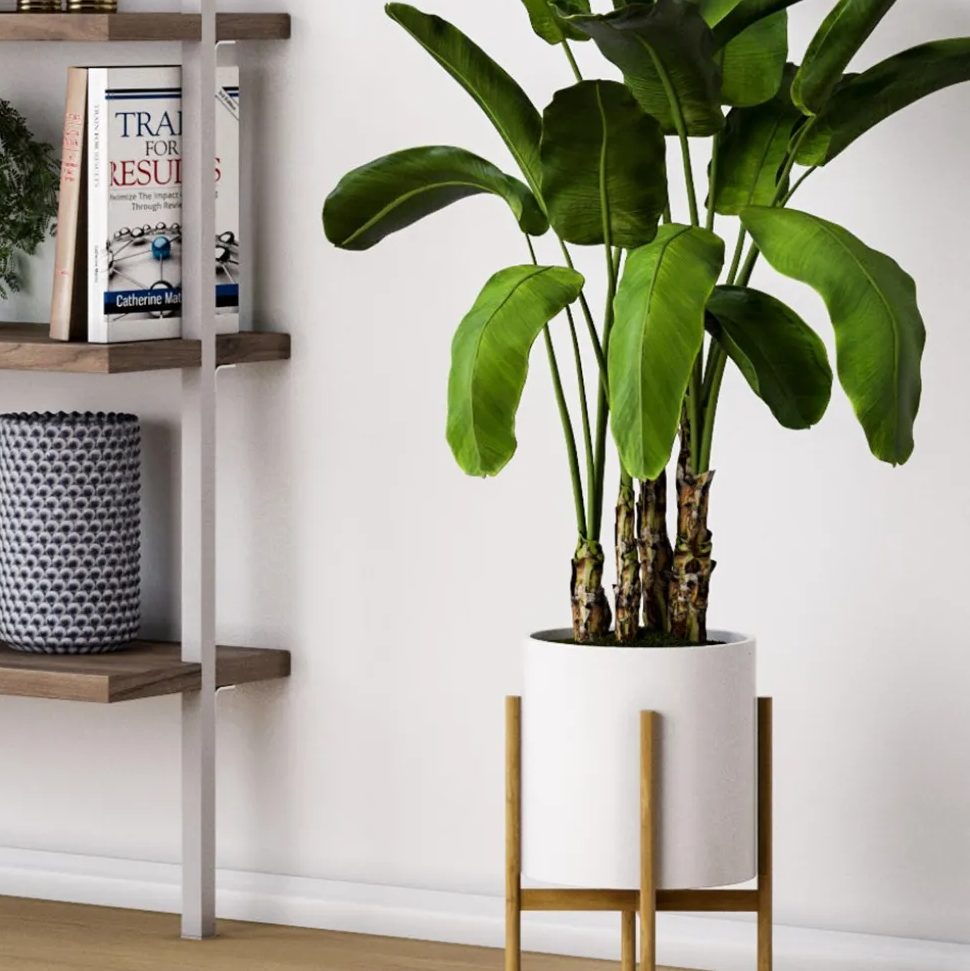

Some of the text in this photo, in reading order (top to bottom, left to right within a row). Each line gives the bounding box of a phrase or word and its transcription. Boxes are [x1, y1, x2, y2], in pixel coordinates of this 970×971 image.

[115, 110, 182, 137] TRAI
[145, 140, 179, 156] FOR
[138, 192, 152, 200] The
[132, 201, 162, 212] Through
[116, 292, 163, 307] Catherine
